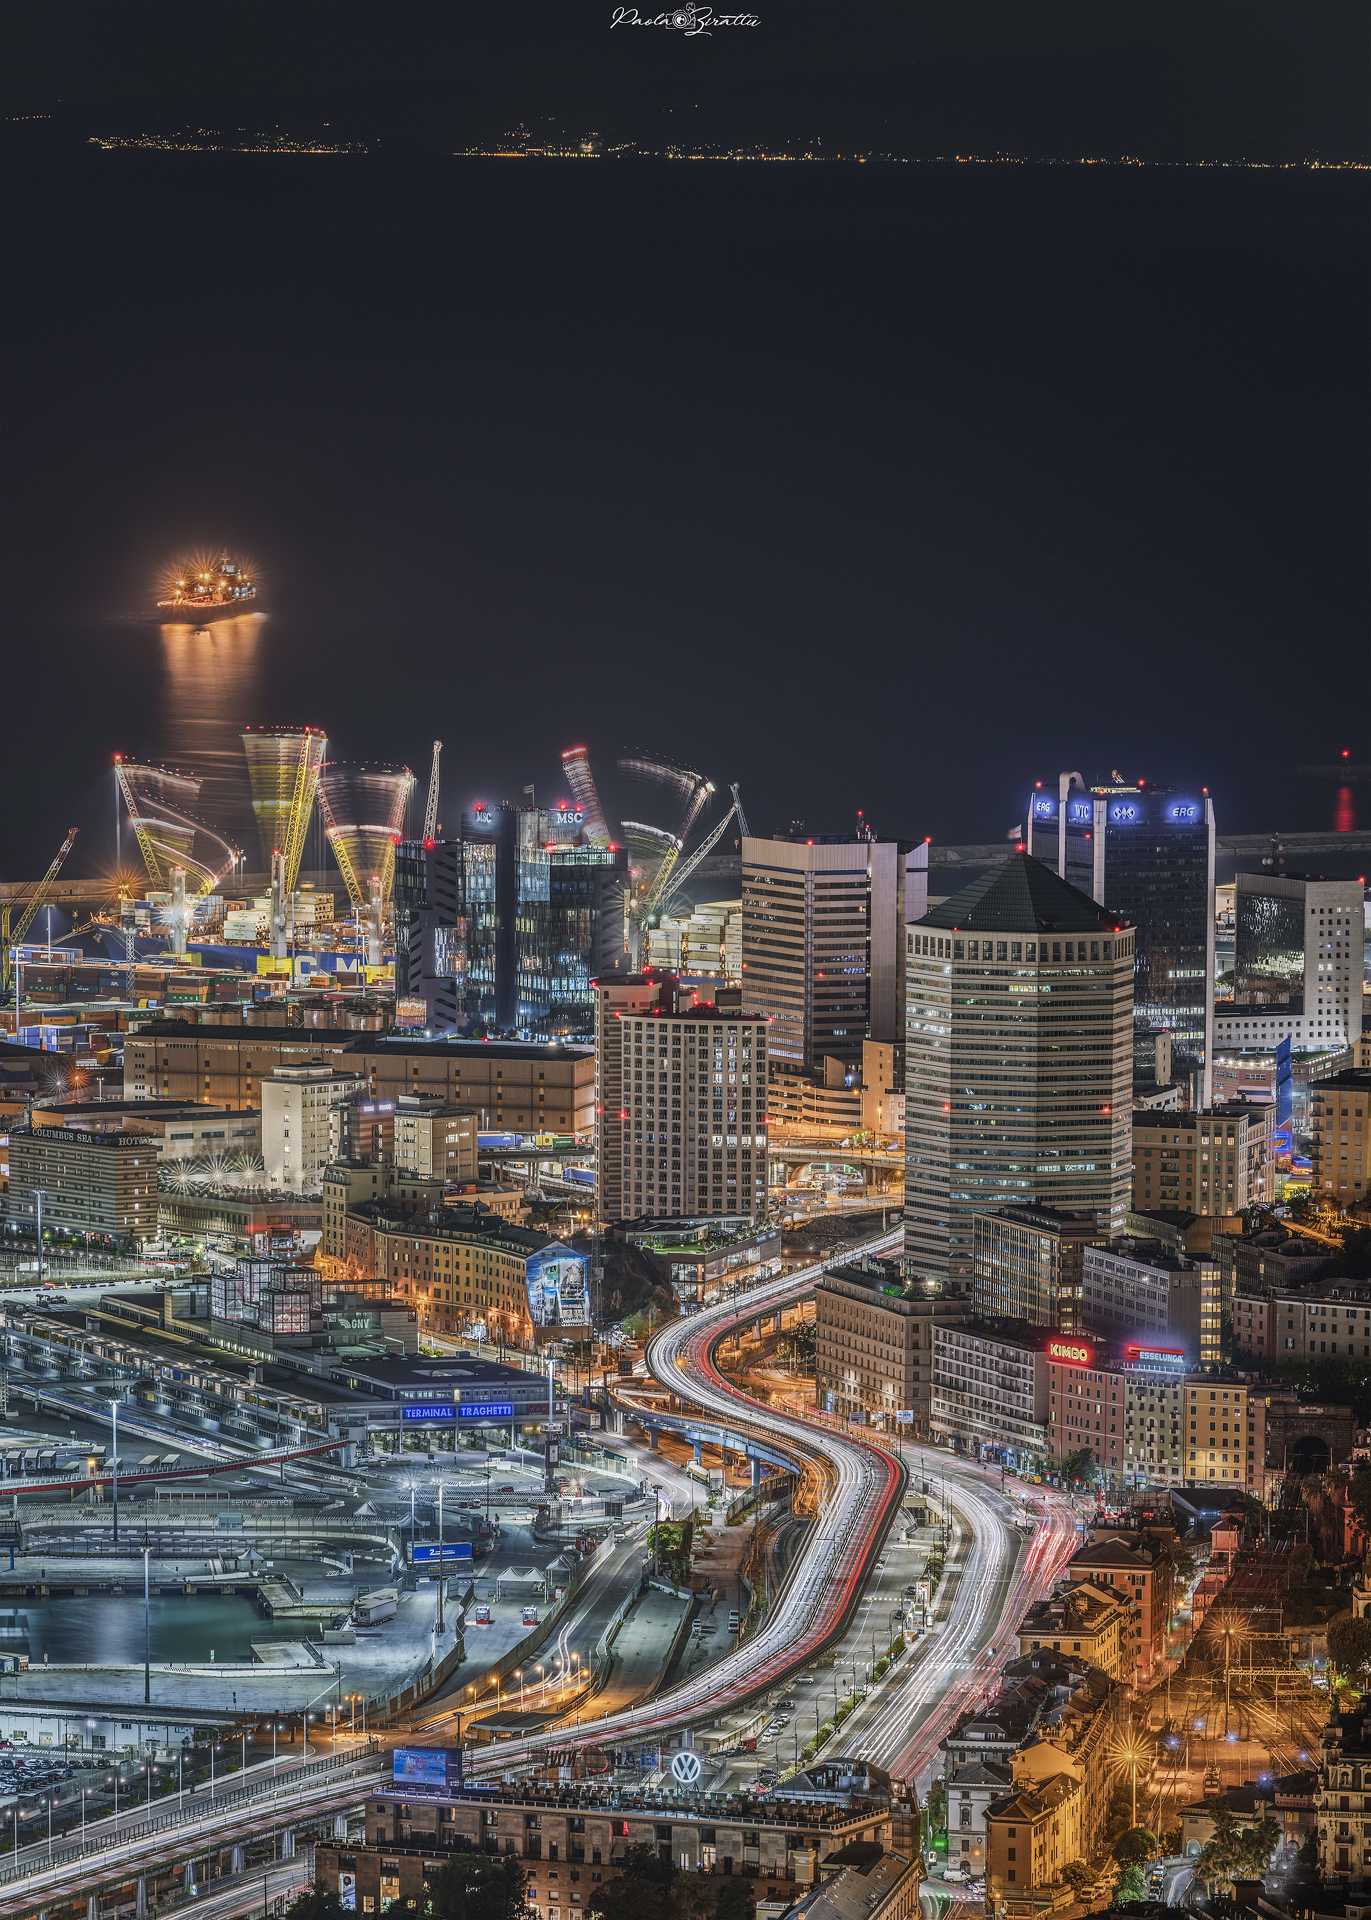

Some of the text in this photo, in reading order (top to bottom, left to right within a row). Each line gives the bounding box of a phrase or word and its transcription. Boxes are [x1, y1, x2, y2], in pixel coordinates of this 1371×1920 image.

[1036, 801, 1051, 812] ERG
[1172, 807, 1195, 817] ERG
[476, 811, 492, 823] MSC
[556, 812, 583, 824] MSC
[32, 1127, 93, 1144] COLUMBUS SEA
[351, 1318, 370, 1329] GNV
[1050, 1343, 1088, 1361] KIMBO
[1139, 1350, 1184, 1363] ESSELUNGA
[405, 1406, 512, 1418] TERMINAL TRAGHETTI
